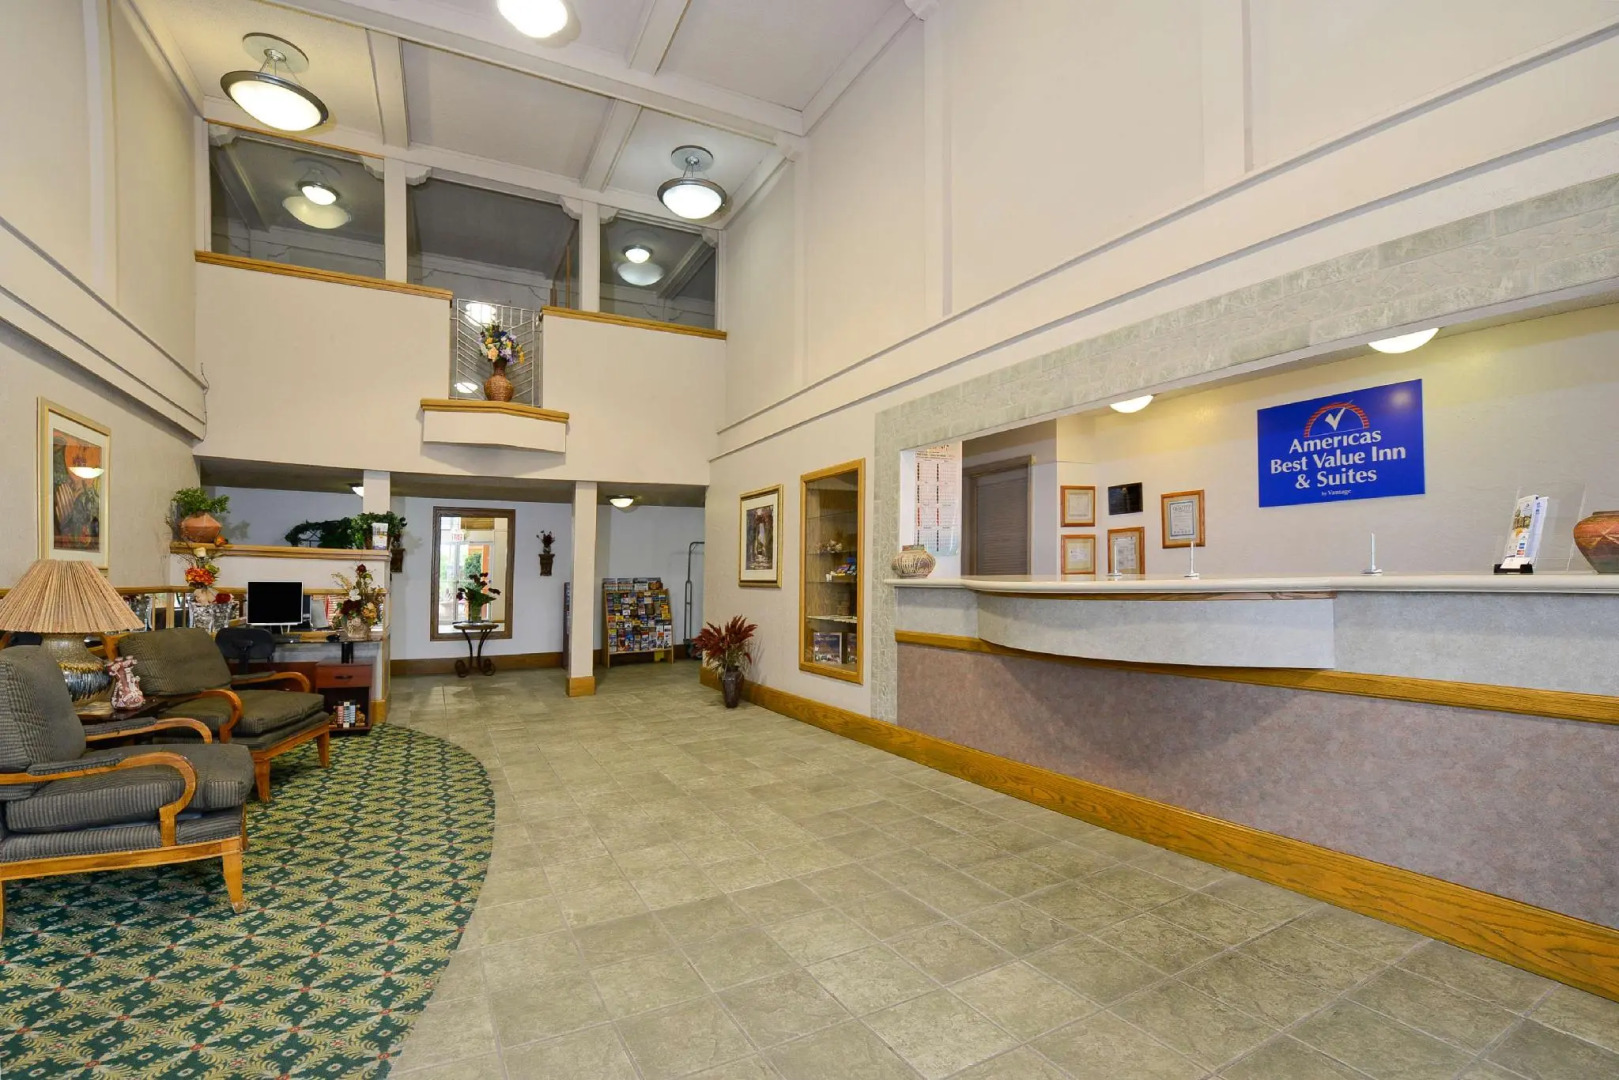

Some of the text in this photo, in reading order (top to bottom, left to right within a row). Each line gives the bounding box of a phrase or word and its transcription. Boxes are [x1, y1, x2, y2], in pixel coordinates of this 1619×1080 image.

[1289, 430, 1382, 454] Americas
[1270, 446, 1406, 474] Best Value Inn
[1295, 467, 1377, 489] & Suites
